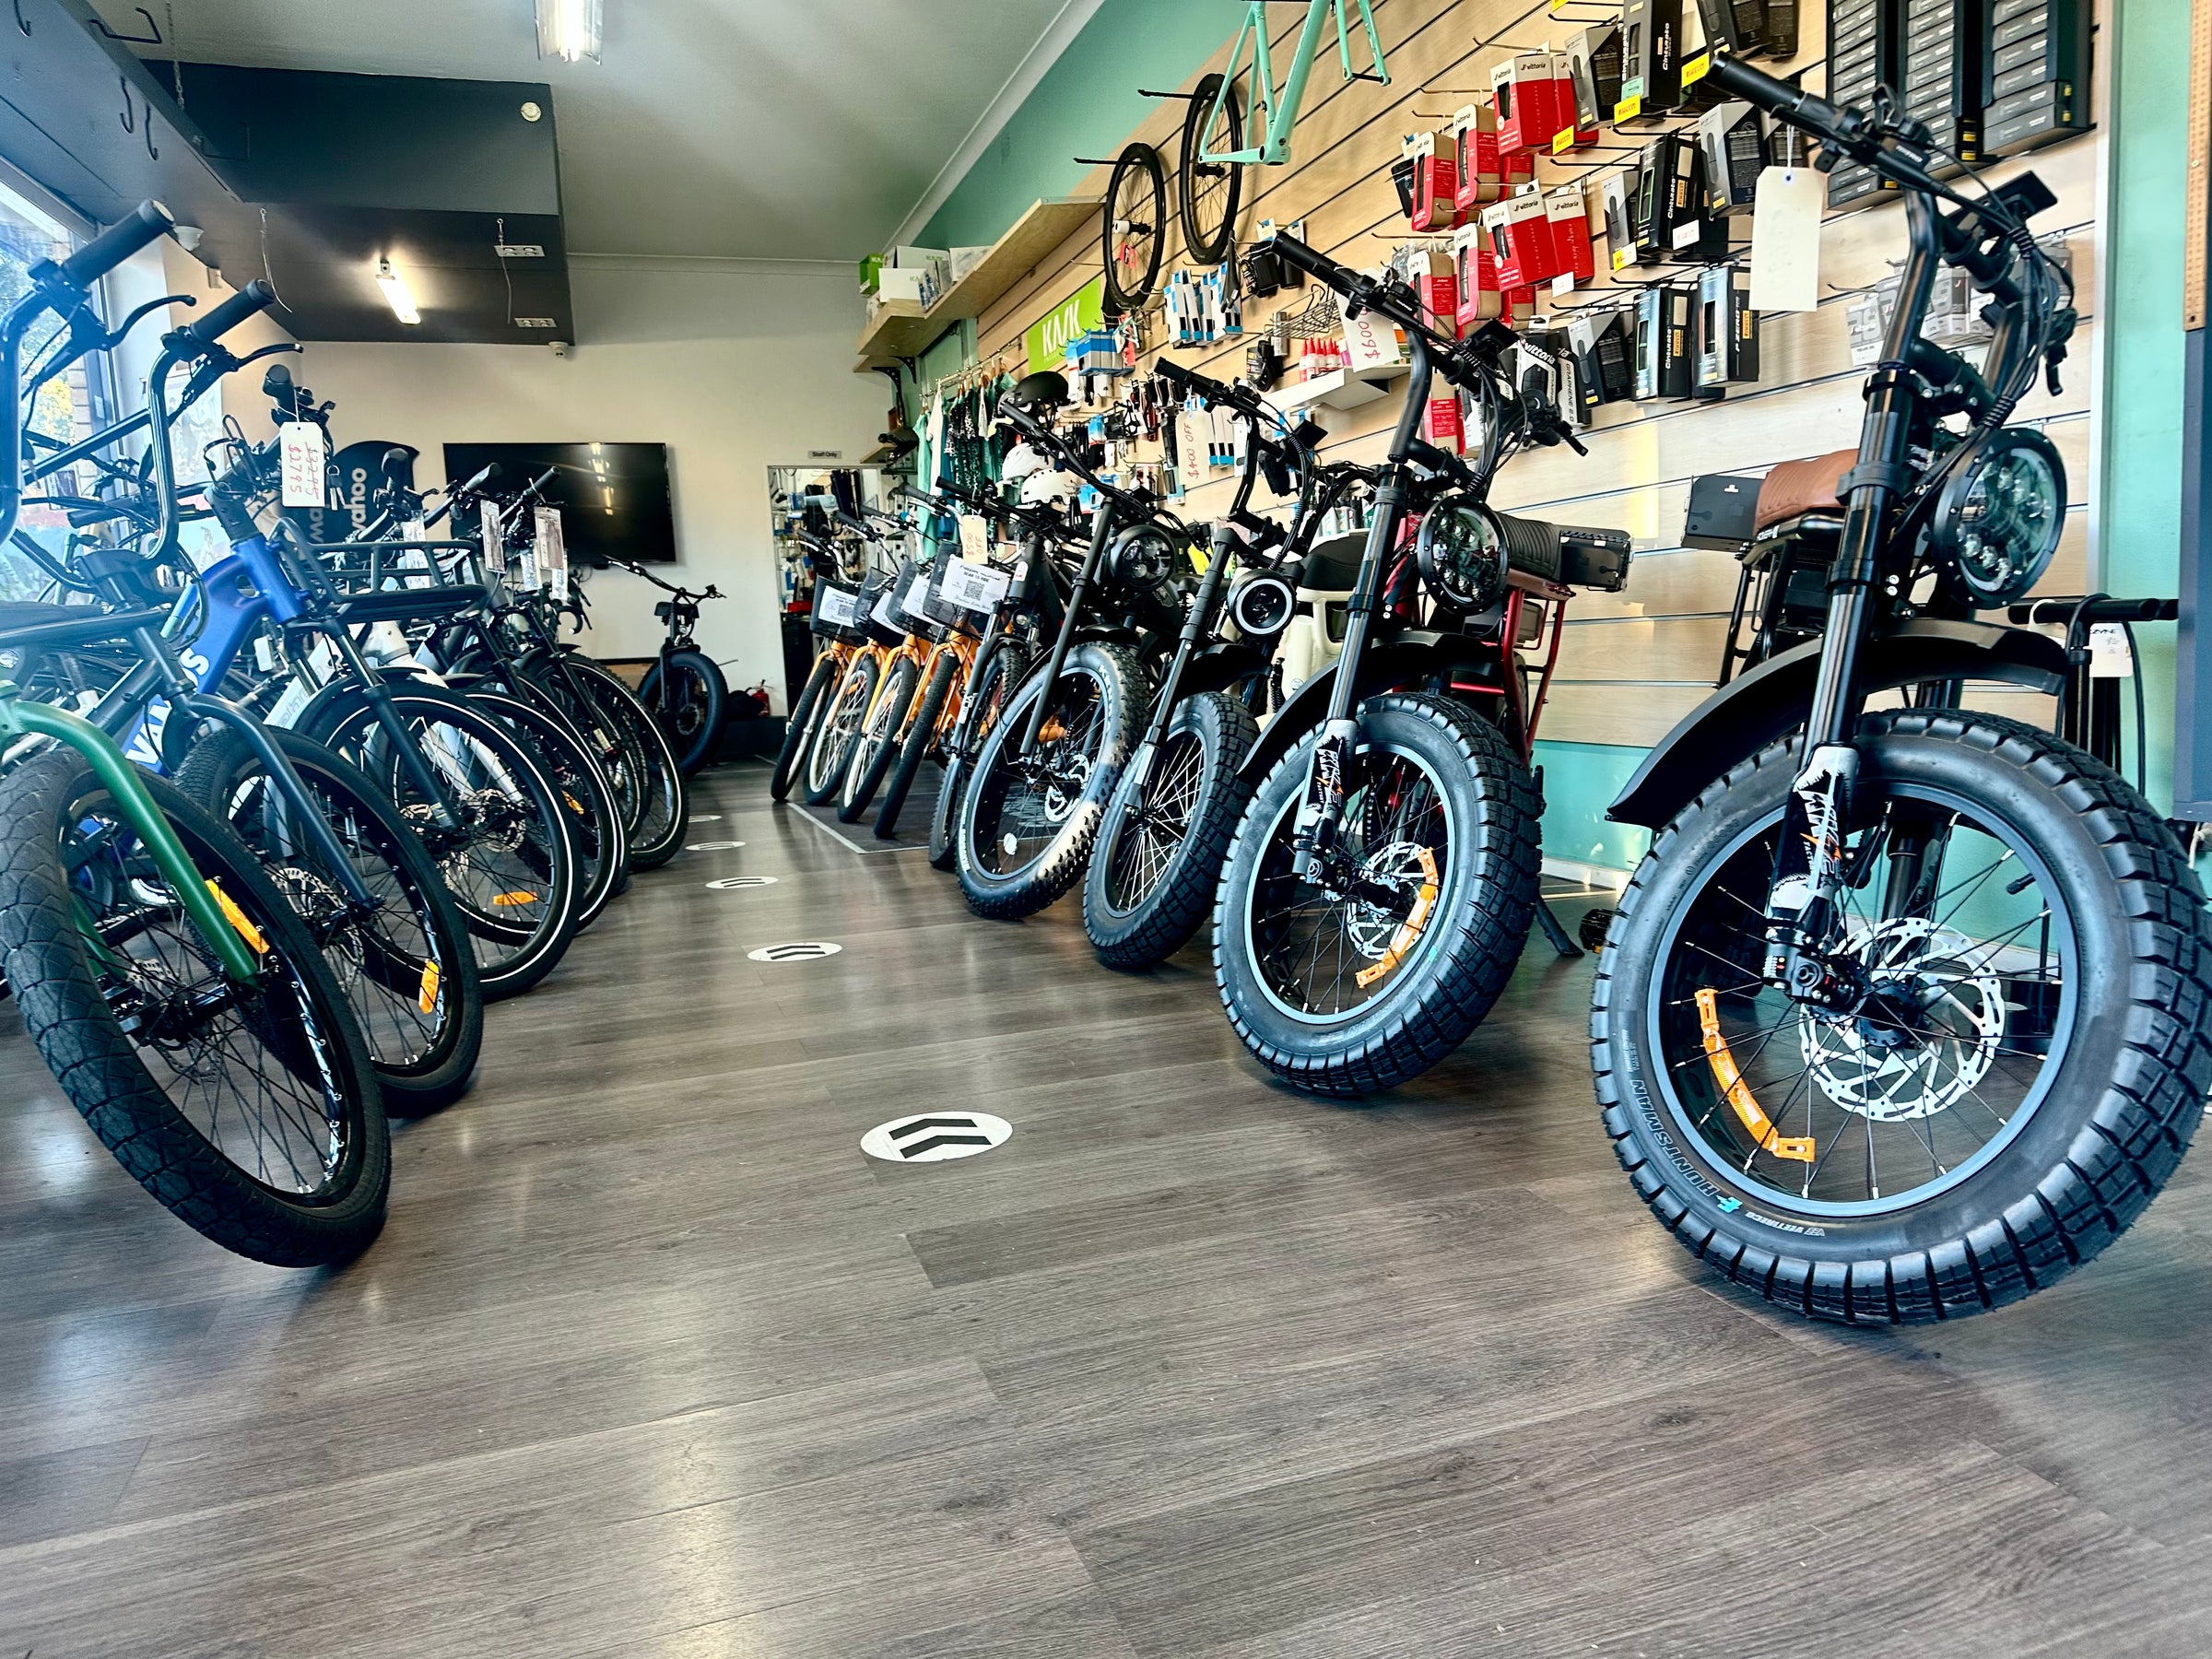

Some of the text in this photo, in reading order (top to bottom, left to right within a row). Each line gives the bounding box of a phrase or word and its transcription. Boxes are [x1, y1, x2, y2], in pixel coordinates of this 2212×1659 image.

[1526, 62, 1547, 70] vittoria
[1667, 178, 1676, 219] Cinturato
[1183, 422, 1194, 442] OFF
[1630, 1079, 1721, 1197] HUNTSMAN
